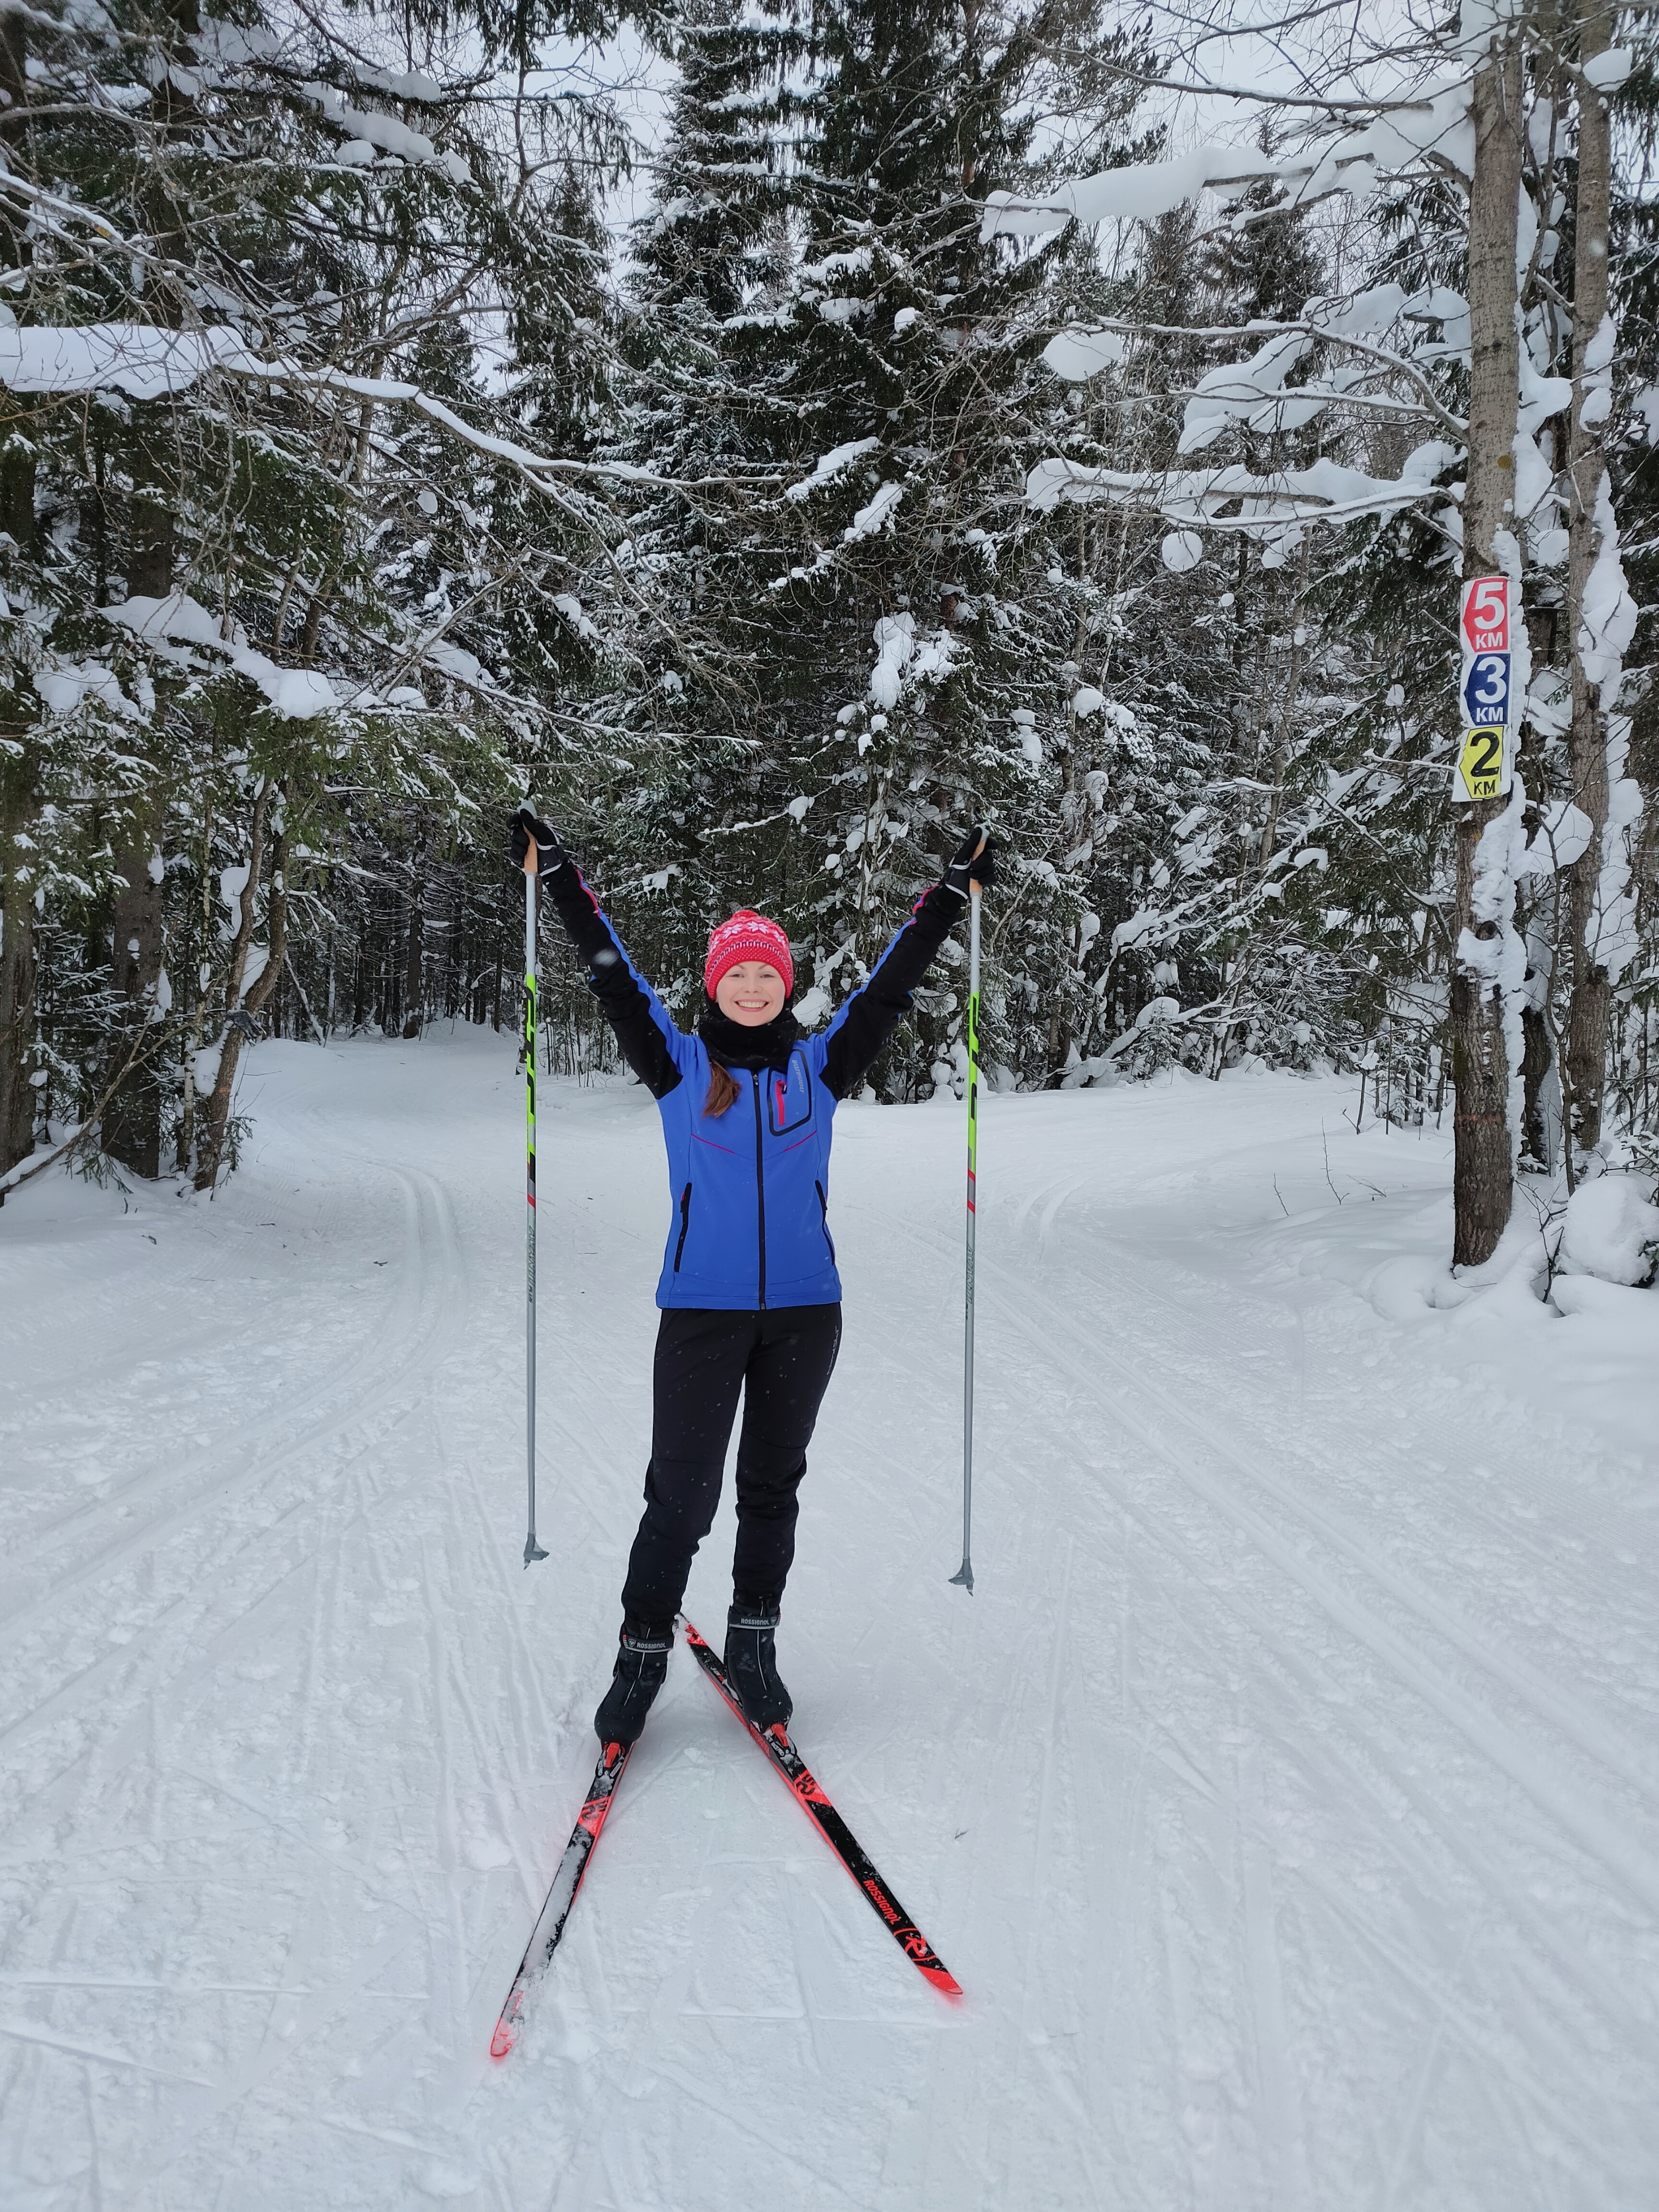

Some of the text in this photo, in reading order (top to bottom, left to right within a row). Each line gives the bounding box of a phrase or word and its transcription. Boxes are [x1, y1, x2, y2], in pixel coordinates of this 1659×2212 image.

[1474, 582, 1505, 630] 5
[1476, 632, 1503, 650] КМ
[1475, 657, 1507, 703] 3
[1476, 707, 1503, 722] КМ
[1470, 731, 1500, 777] 2
[1474, 779, 1496, 795] КМ
[863, 1880, 900, 1925] ROSSIGNOL
